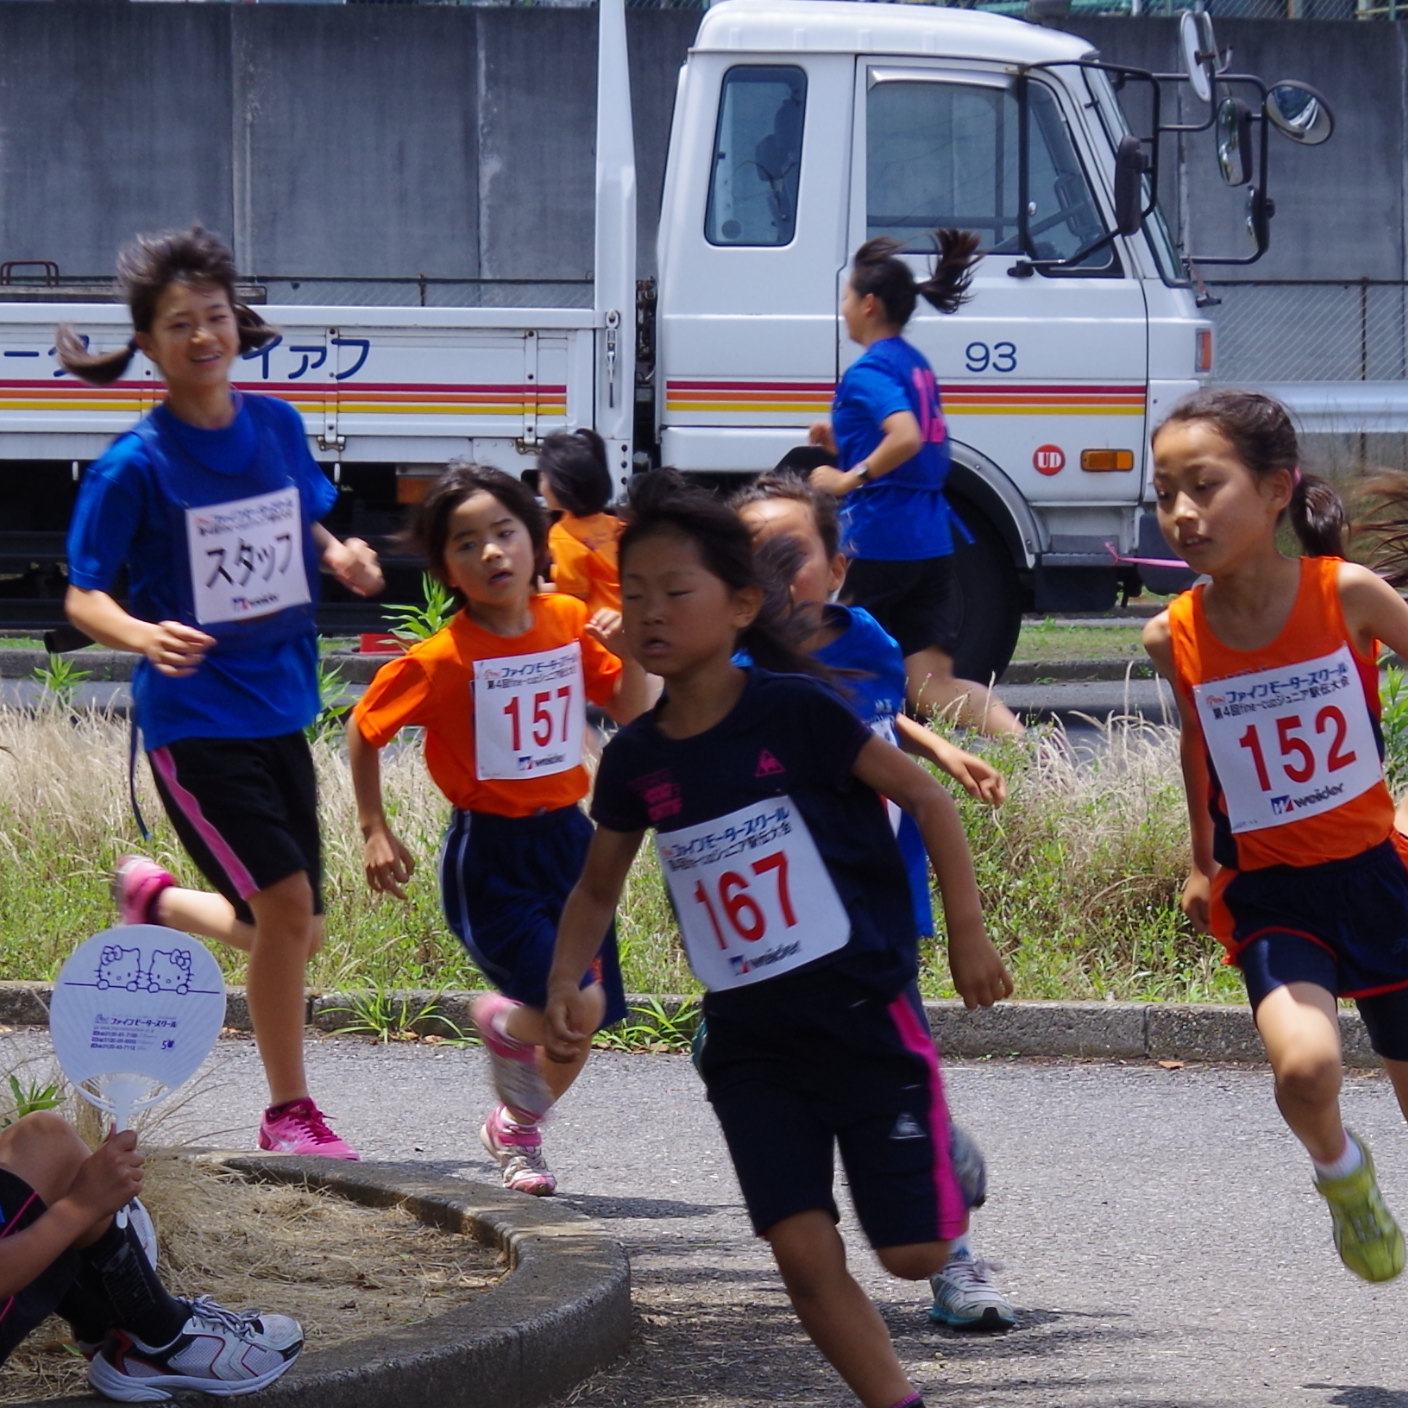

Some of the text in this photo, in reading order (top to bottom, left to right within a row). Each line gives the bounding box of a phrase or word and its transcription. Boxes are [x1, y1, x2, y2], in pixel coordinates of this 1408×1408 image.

[965, 341, 1018, 373] 93
[1036, 451, 1063, 469] UD
[205, 533, 291, 589] スタッフ
[1225, 662, 1347, 704] ファインモータースクール
[503, 685, 571, 752] 157
[1239, 704, 1357, 792] 152
[694, 850, 799, 951] 167
